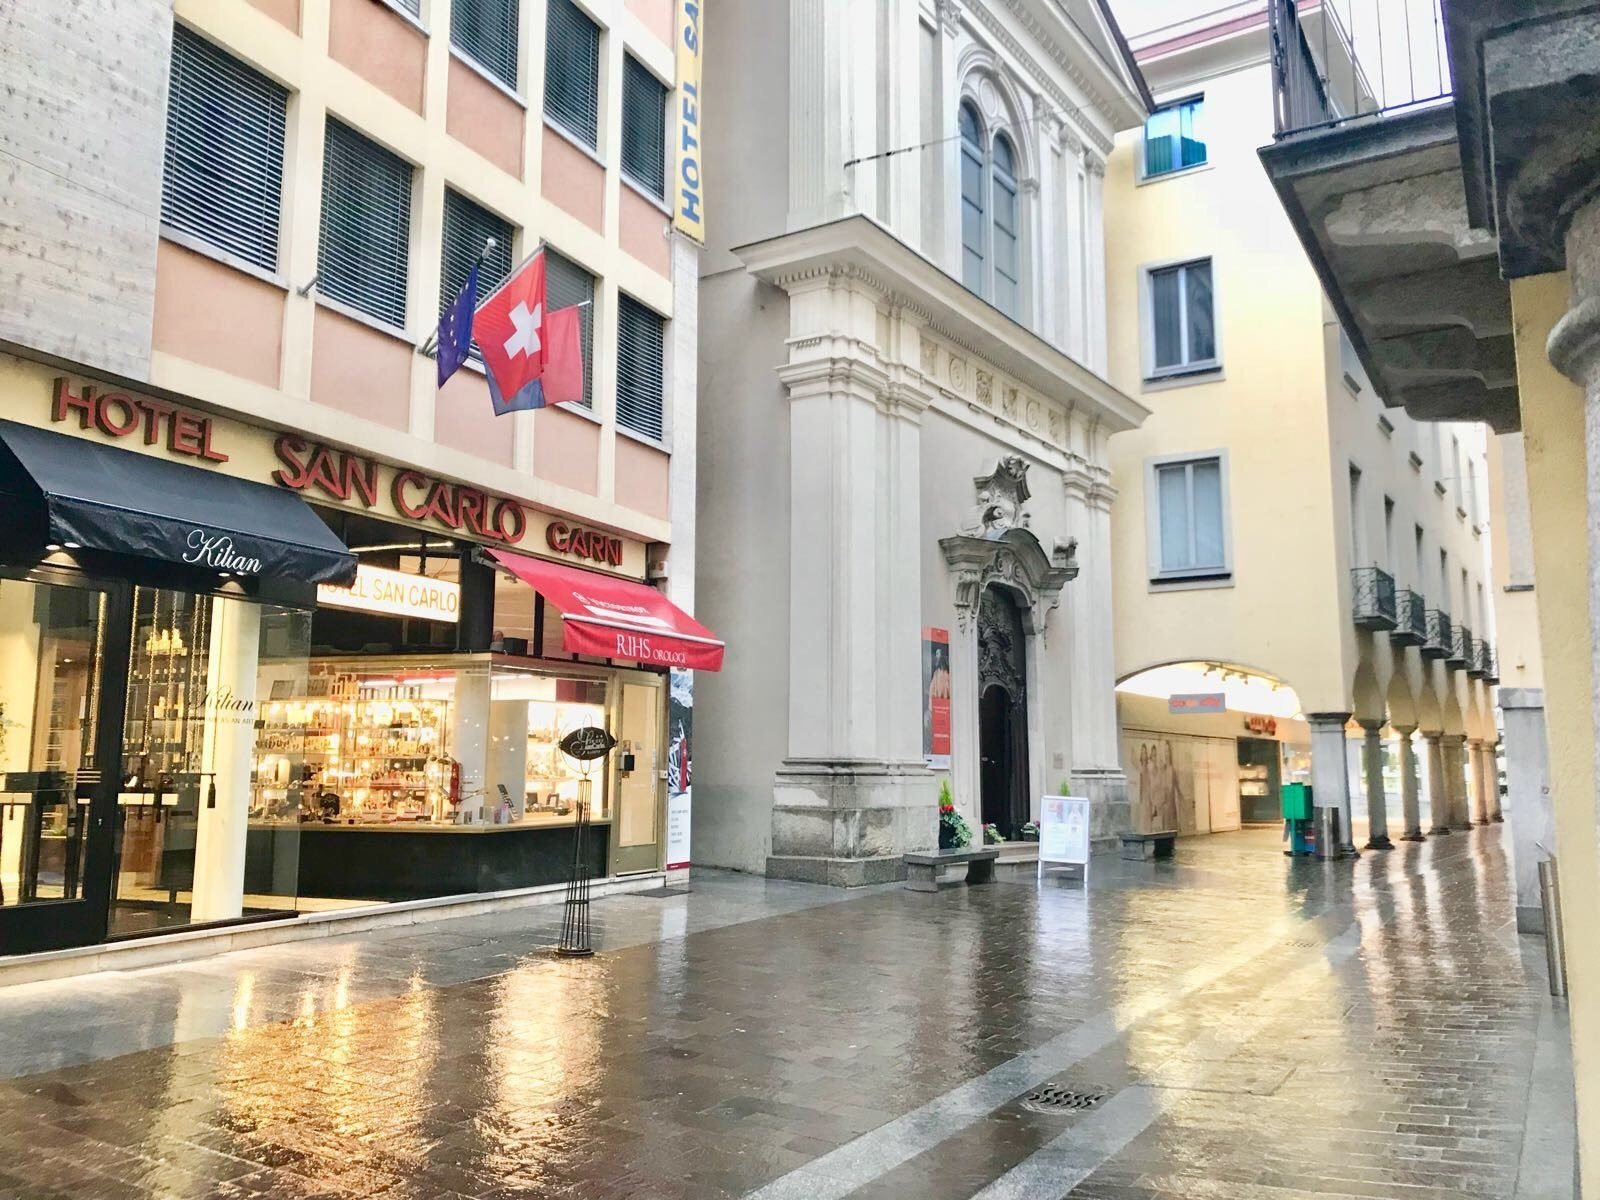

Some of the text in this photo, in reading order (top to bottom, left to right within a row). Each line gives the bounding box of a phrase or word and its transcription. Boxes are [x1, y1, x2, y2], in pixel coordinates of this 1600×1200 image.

[682, 0, 700, 224] HOTEL SA
[51, 376, 623, 566] HOTEL SAN CARLO GARNI
[182, 529, 262, 572] Kilian
[373, 578, 404, 603] SAN
[409, 585, 457, 613] CARLO
[616, 633, 651, 659] RIHS
